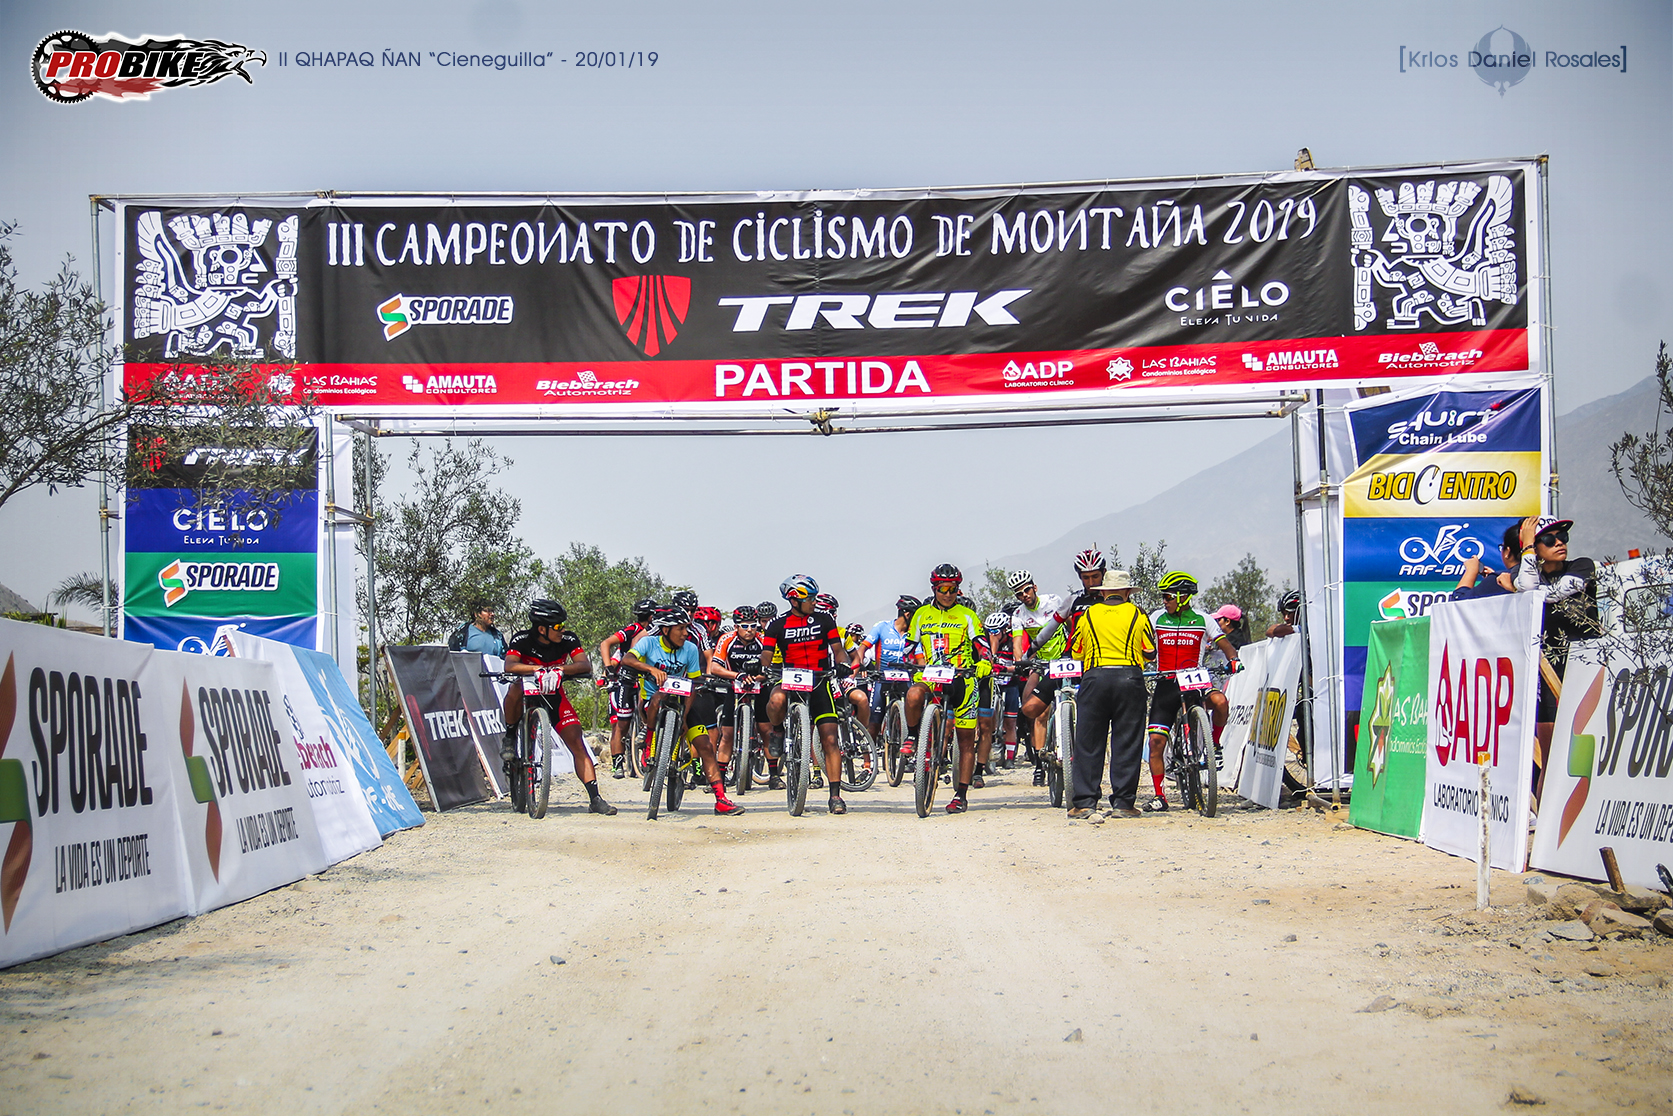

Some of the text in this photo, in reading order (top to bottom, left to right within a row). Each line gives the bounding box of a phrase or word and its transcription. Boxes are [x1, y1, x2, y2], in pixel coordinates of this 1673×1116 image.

[326, 222, 365, 266] III
[375, 221, 656, 266] CAMPEONATO
[673, 220, 716, 263] DE
[931, 214, 975, 257] DE
[990, 199, 1208, 256] MONTAÑA
[1223, 196, 1318, 244] 2019
[409, 298, 510, 321] SPORADE
[718, 289, 1033, 332] TREK
[1142, 355, 1217, 369] LAS BAHIAS
[1266, 349, 1338, 365] AMAUTA
[1378, 348, 1483, 364] Bieberach
[1021, 360, 1074, 379] ADP
[1265, 362, 1339, 371] CONSULTORES
[1386, 359, 1475, 370] Automotriz
[303, 375, 378, 387] LAS BAHIAS
[715, 360, 931, 397] PARTIDA
[1142, 369, 1183, 377] Condominios
[427, 375, 497, 389] AMAUTA
[536, 378, 639, 390] Bieberach
[544, 388, 632, 396] Automotriz
[1399, 432, 1488, 445] Chain Lube
[186, 565, 276, 588] SPORADE
[935, 669, 943, 677] 1
[1057, 662, 1075, 672] 10
[672, 680, 681, 689] 6
[794, 673, 803, 683] 5
[1185, 672, 1203, 683] 11
[1451, 657, 1514, 768] ADP
[424, 709, 469, 741] TREK
[29, 666, 153, 818] SPORADE
[199, 686, 291, 798] SPORADE
[1433, 783, 1478, 817] LABORATORIO
[1595, 799, 1611, 835] LA
[1607, 800, 1631, 837] VIDA
[1626, 801, 1645, 839] ES
[1639, 803, 1660, 841] UN
[236, 806, 299, 854] LA VIDA ES UN DEPORTE
[55, 833, 151, 894] LA VIDA ES UN DEPORTE
